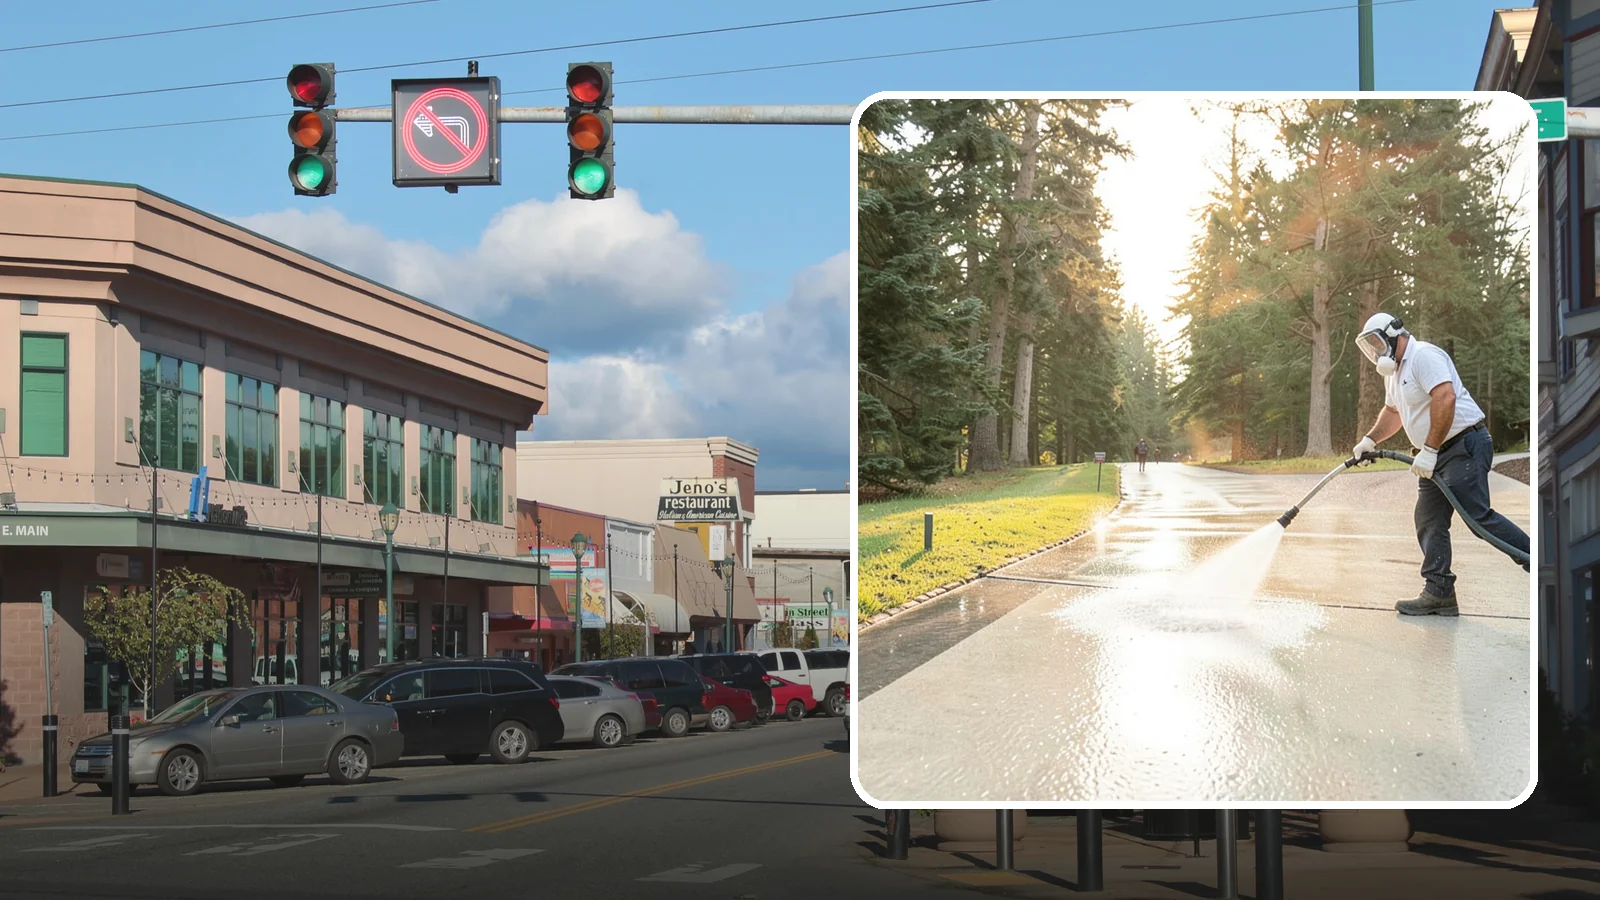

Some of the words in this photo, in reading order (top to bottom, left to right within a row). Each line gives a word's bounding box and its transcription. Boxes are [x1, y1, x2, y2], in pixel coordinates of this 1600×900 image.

[670, 480, 727, 494] Jeno's
[665, 497, 731, 509] restaurant
[659, 510, 681, 519] Italian
[686, 509, 715, 519] American
[715, 510, 738, 519] Cuisine
[2, 525, 13, 536] E.
[15, 525, 49, 536] MAIN
[797, 607, 828, 616] Street
